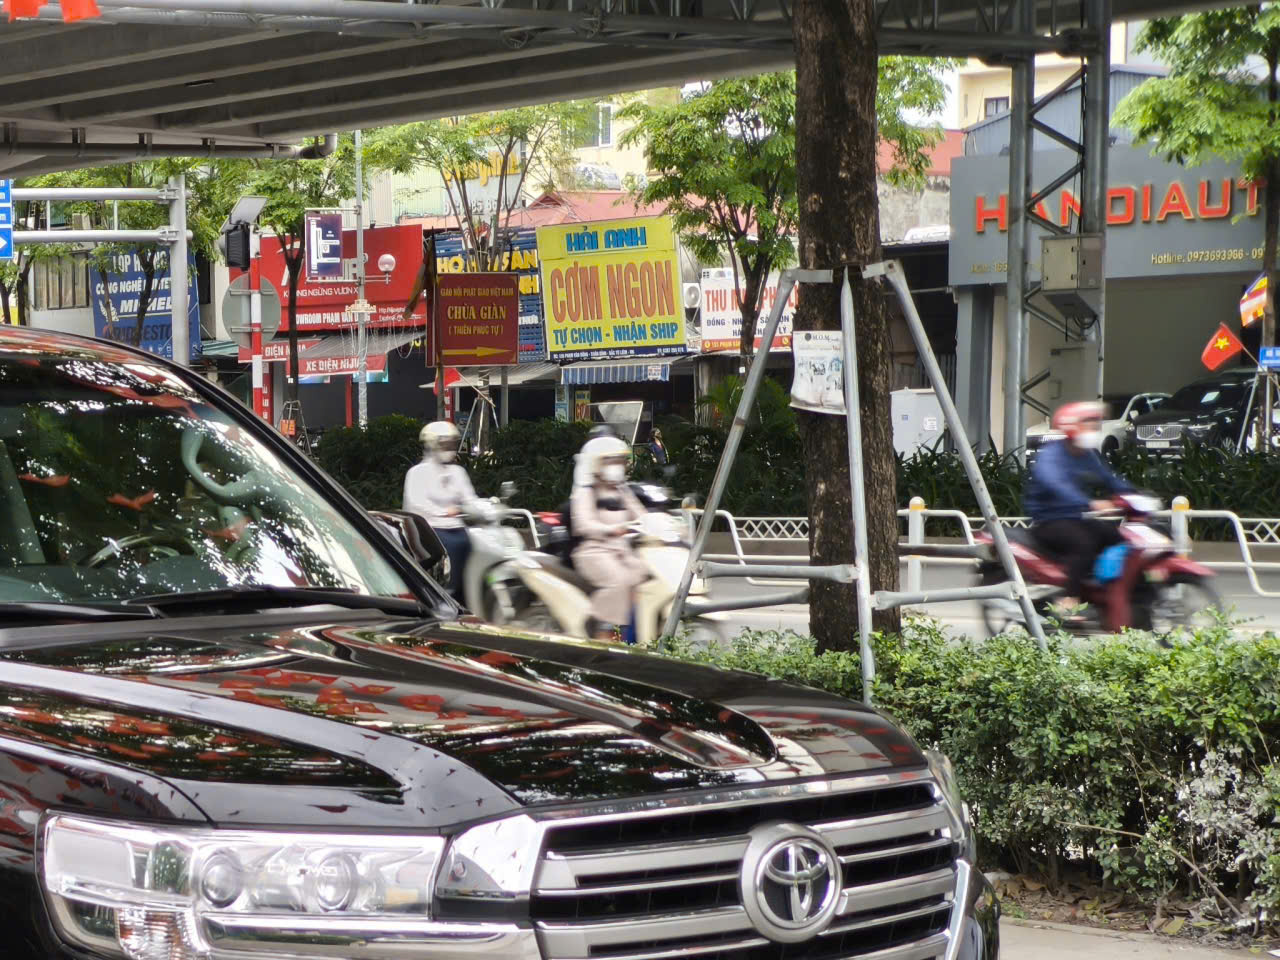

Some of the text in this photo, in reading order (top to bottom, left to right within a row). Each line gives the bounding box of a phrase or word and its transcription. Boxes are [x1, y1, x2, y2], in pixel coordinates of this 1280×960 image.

[975, 176, 1268, 234] HANOIAUT
[565, 225, 647, 252] HẢI ANH
[550, 260, 675, 323] CƠM NGON
[705, 289, 727, 312] THU
[296, 313, 322, 325] OWROOM
[447, 303, 477, 320] CHÙA
[553, 327, 568, 348] TỰ
[570, 326, 603, 347] CHỌN
[613, 321, 647, 344] NHẬN
[650, 322, 679, 340] SHIP
[306, 360, 317, 372] XE
[318, 358, 339, 373] ĐIỆN
